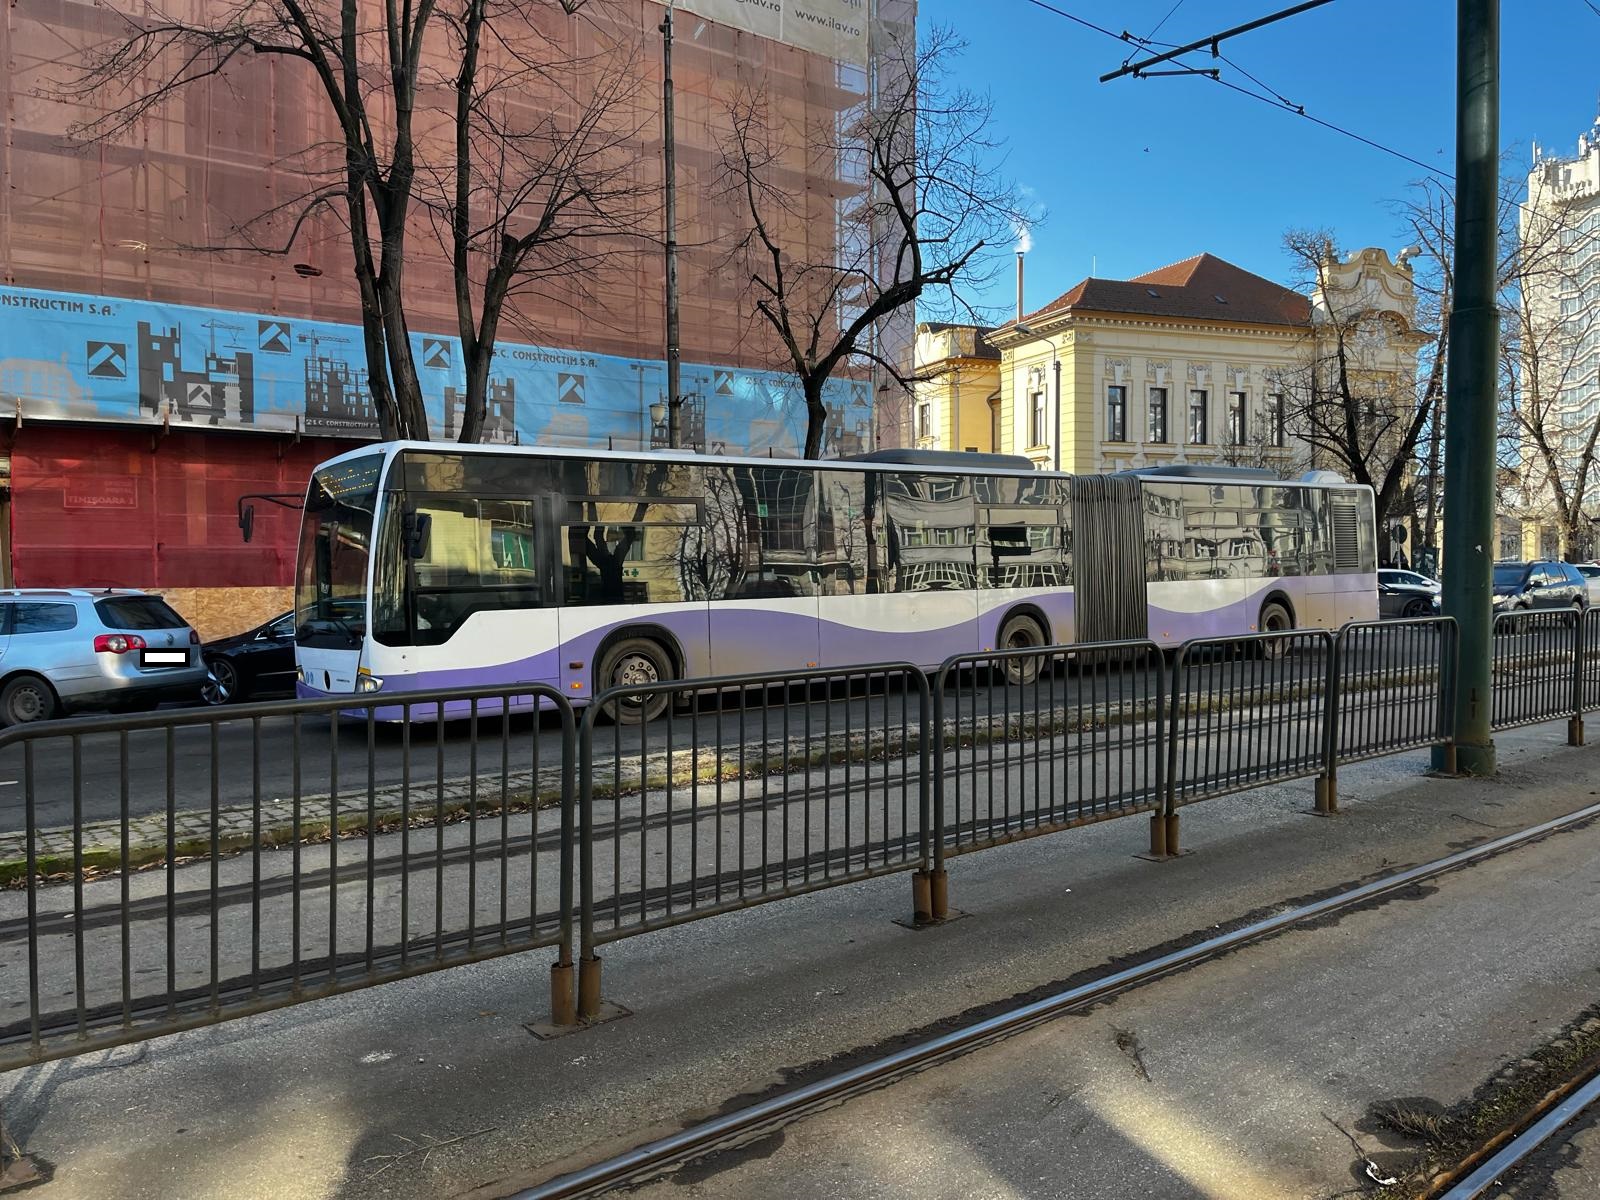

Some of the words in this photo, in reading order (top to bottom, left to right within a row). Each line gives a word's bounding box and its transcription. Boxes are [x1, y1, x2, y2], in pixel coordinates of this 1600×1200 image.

[795, 9, 861, 37] www.ilav.ro
[0, 294, 84, 313] NSTRUCTIM
[88, 303, 116, 317] S.A.
[512, 350, 578, 367] CONSTRUCTIM
[580, 358, 598, 369] S.A.
[326, 420, 370, 429] CONSTRUCTIM
